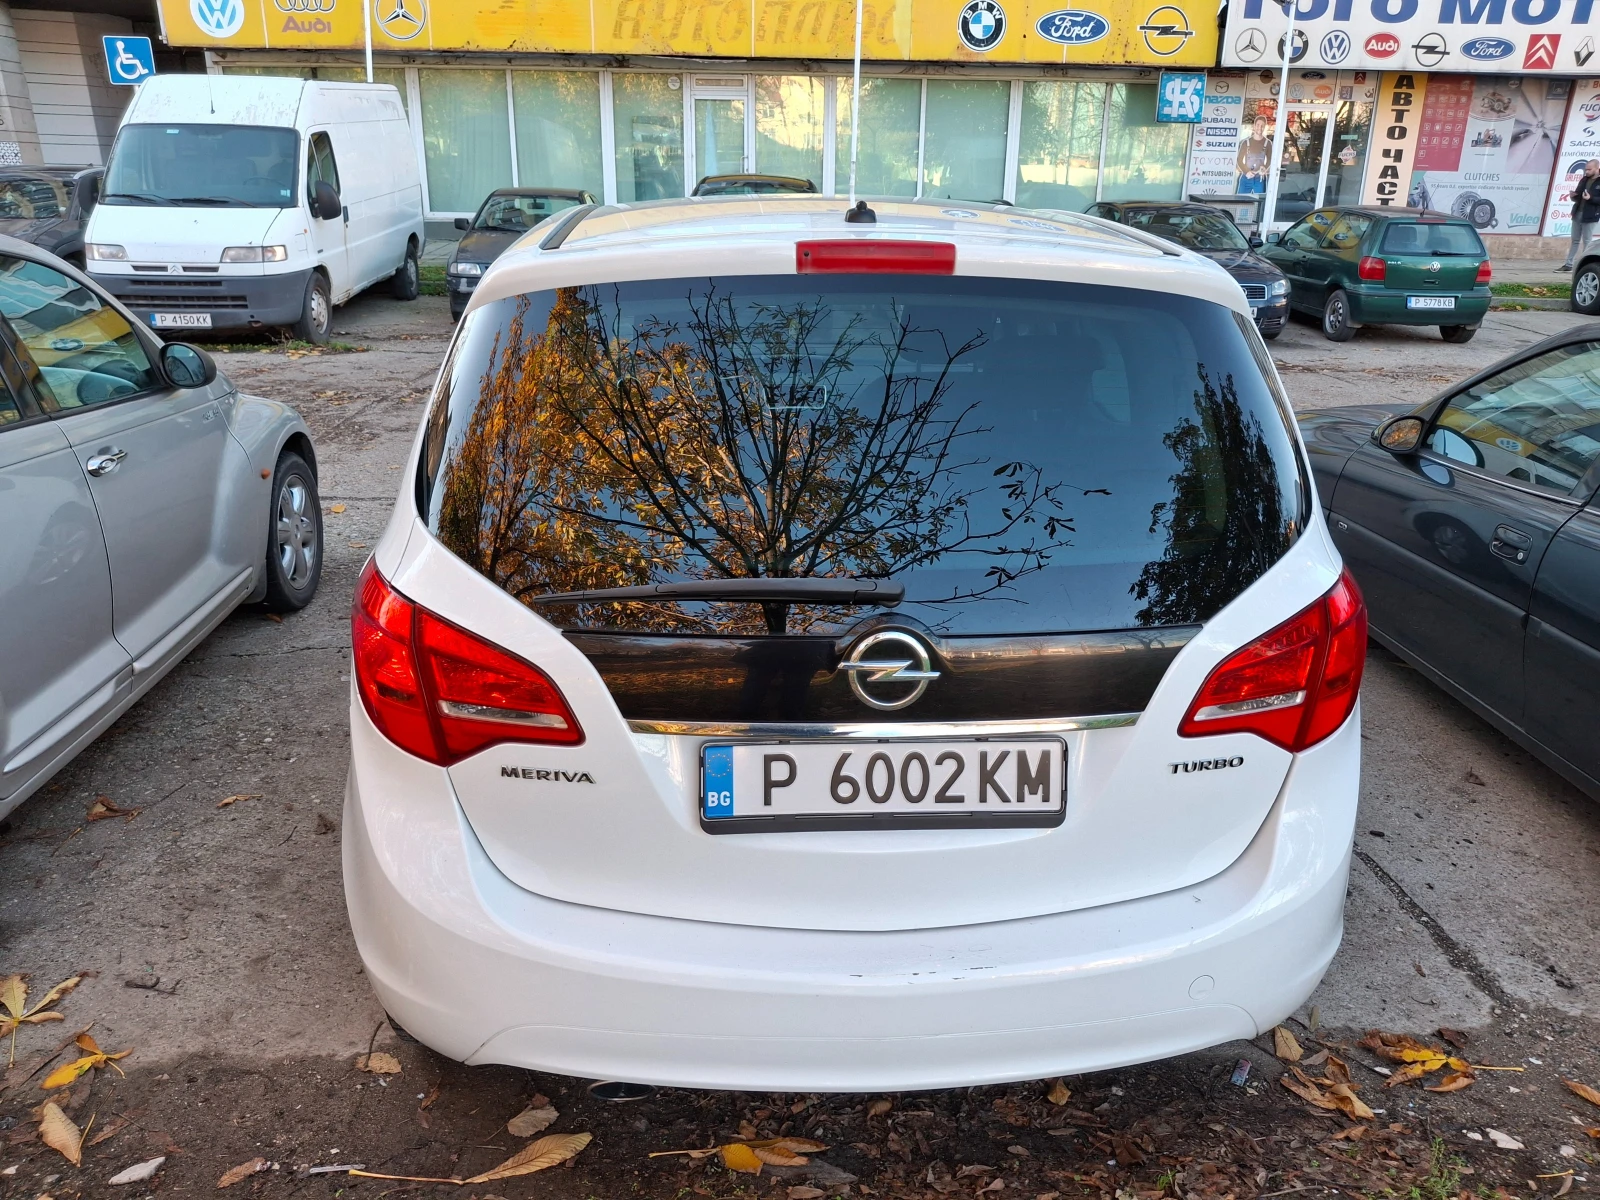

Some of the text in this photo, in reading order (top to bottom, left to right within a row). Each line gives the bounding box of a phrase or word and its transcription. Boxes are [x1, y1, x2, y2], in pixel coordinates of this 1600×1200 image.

[964, 1, 1003, 20] BMW
[282, 16, 331, 33] Audi
[1051, 14, 1096, 37] Ford
[1366, 39, 1398, 51] Audi
[1471, 41, 1503, 56] Ford
[1207, 128, 1236, 136] NISSAN
[1193, 157, 1234, 166] TOYOTA
[1464, 173, 1500, 181] CLUTCHES
[1510, 213, 1540, 224] Valeo
[1554, 223, 1571, 233] Val
[1168, 755, 1244, 774] TURBO
[500, 765, 597, 784] MERIVA
[708, 791, 731, 807] BG
